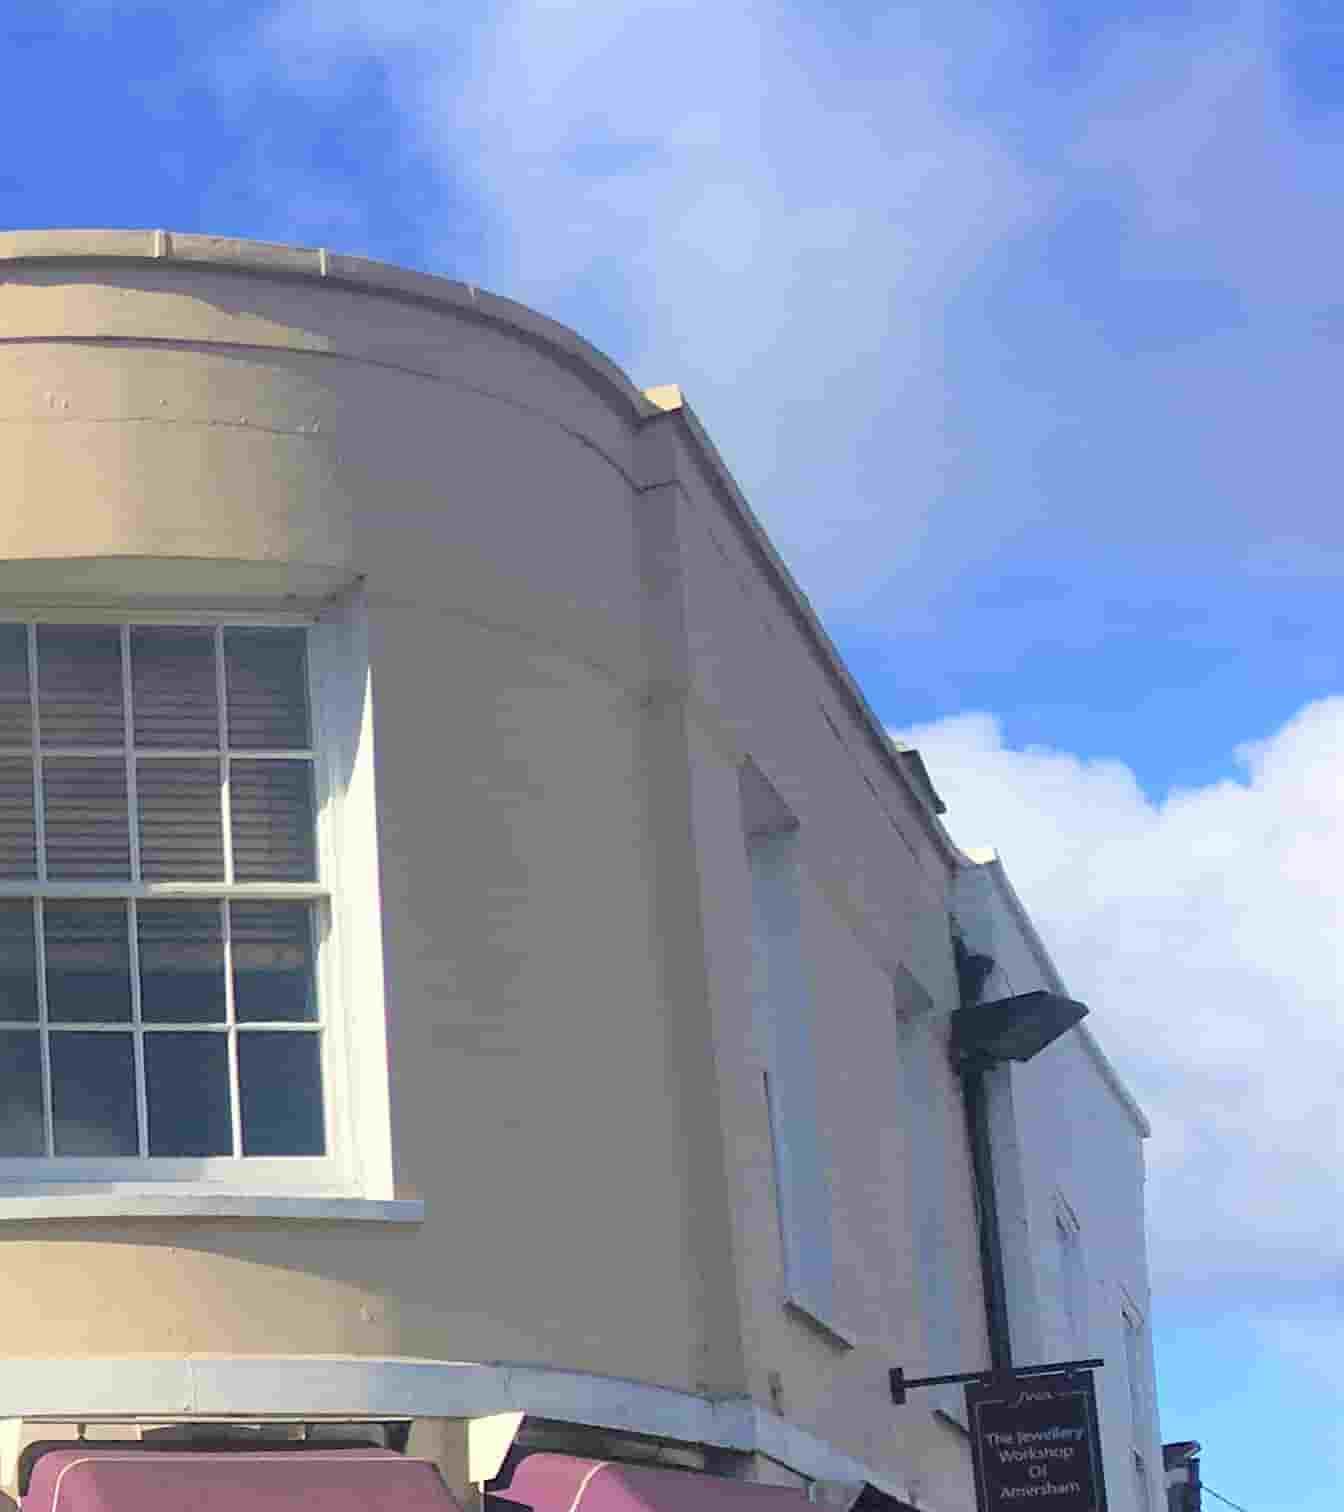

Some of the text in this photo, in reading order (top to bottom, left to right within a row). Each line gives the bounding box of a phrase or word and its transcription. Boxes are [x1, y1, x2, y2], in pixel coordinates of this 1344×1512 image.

[984, 1425, 1086, 1447] The Jewellery
[999, 1447, 1074, 1464] Workshop
[999, 1481, 1081, 1499] Amersham
